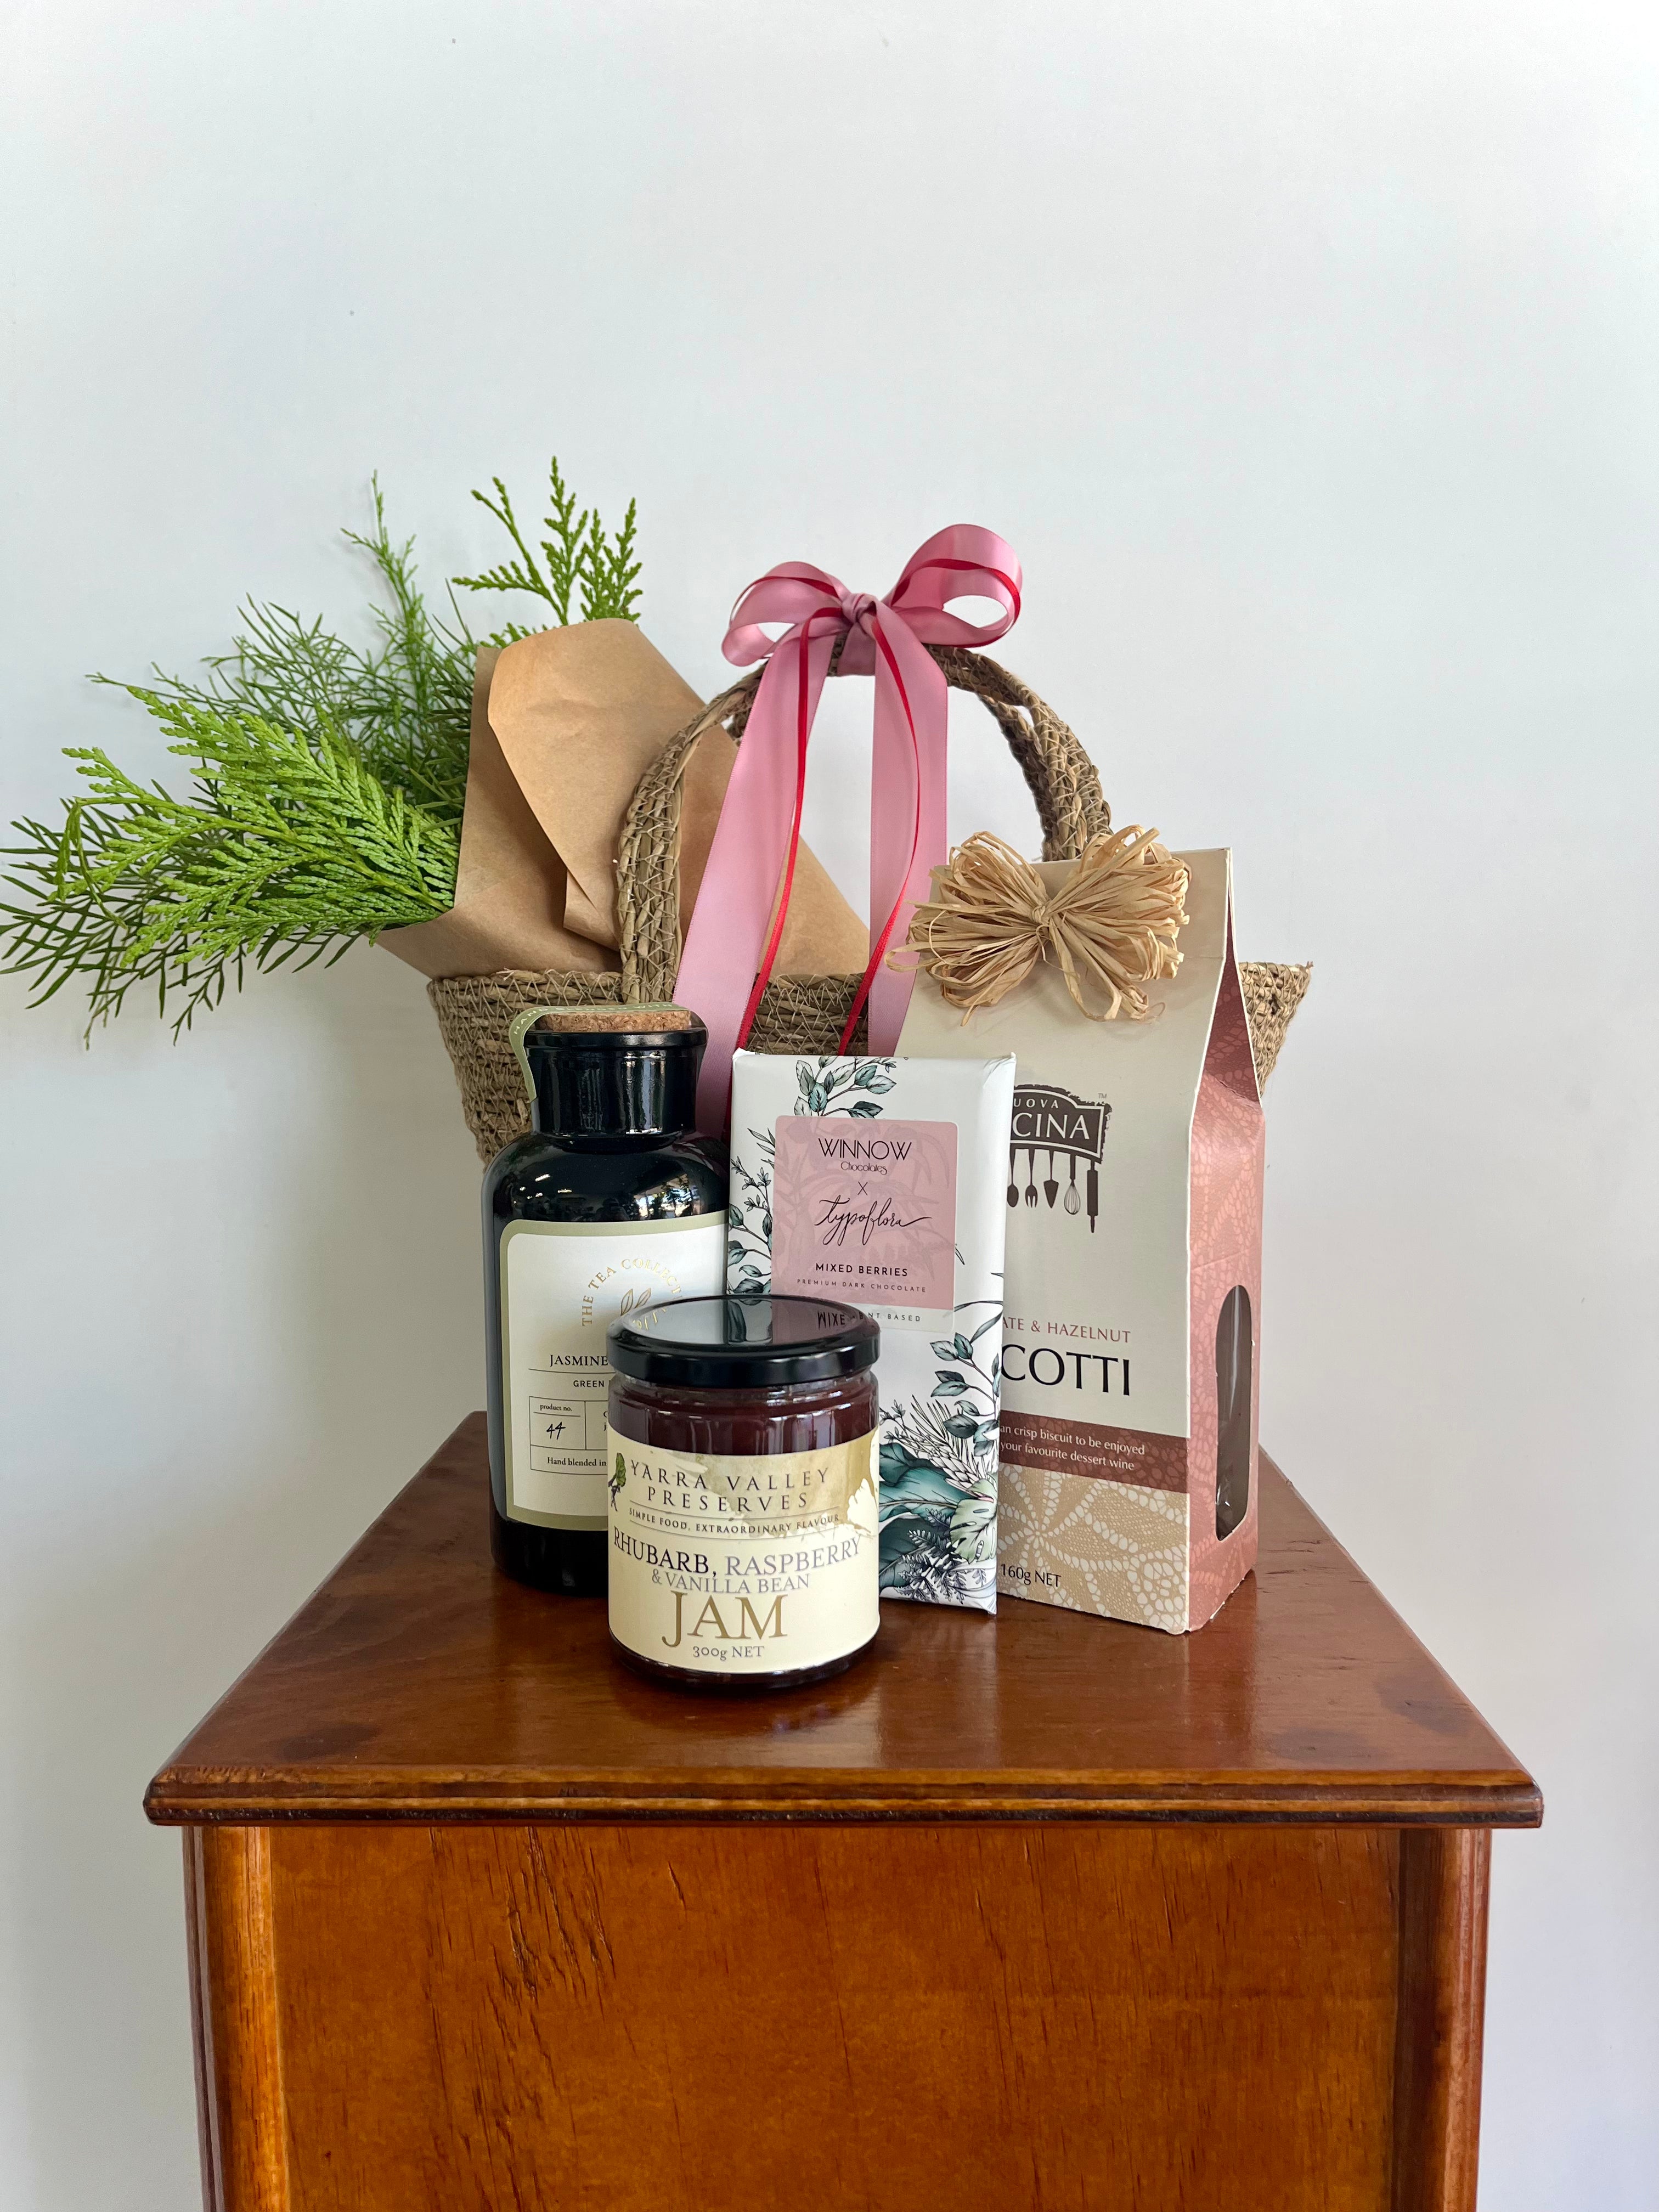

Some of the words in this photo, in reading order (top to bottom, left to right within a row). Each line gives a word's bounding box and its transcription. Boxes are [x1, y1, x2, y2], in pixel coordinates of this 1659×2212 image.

[1012, 1112, 1090, 1140] CINA
[818, 1138, 912, 1160] WINNOW
[840, 1161, 887, 1175] Chocolates
[816, 1263, 853, 1273] MIXED
[859, 1266, 908, 1277] BERRIES
[582, 1295, 593, 1327] THE
[588, 1266, 617, 1290] TEA
[871, 1284, 926, 1293] CHOCOLATE
[888, 1313, 921, 1322] BASED
[1031, 1320, 1040, 1333] &
[1048, 1322, 1131, 1343] HAZELNUT
[550, 1355, 608, 1367] JASMINE
[1001, 1344, 1130, 1396] COTTI
[573, 1380, 605, 1388] GREEN
[540, 1404, 562, 1412] product
[1014, 1426, 1037, 1441] crisp
[1040, 1428, 1072, 1444] biscuit
[1076, 1434, 1086, 1446] to
[1088, 1436, 1101, 1448] be
[1104, 1442, 1145, 1455] enjoyed
[548, 1457, 566, 1466] Hand
[568, 1458, 596, 1466] blended
[1000, 1441, 1022, 1452] your
[1025, 1442, 1067, 1459] favourite
[1070, 1450, 1106, 1466] dessert
[1109, 1458, 1135, 1471] wine
[631, 1459, 708, 1489] YARRA
[726, 1467, 829, 1491] VALLEY
[648, 1486, 808, 1512] PRESERVES
[629, 1508, 656, 1523] SIMPLE
[659, 1517, 691, 1531] FOOD,
[696, 1522, 792, 1533] EXTRAORDINARY
[796, 1514, 839, 1530] FLAVOUR
[614, 1526, 716, 1577] RHUBARB,
[725, 1537, 862, 1576] RASPBERRY
[652, 1569, 662, 1585] &
[665, 1571, 751, 1593] VANILLA
[758, 1573, 810, 1593] BEAN
[1001, 1564, 1031, 1585] 160g
[1035, 1570, 1062, 1587] NET
[662, 1590, 788, 1647] JAM
[693, 1646, 728, 1661] 300g
[731, 1645, 765, 1657] NET
